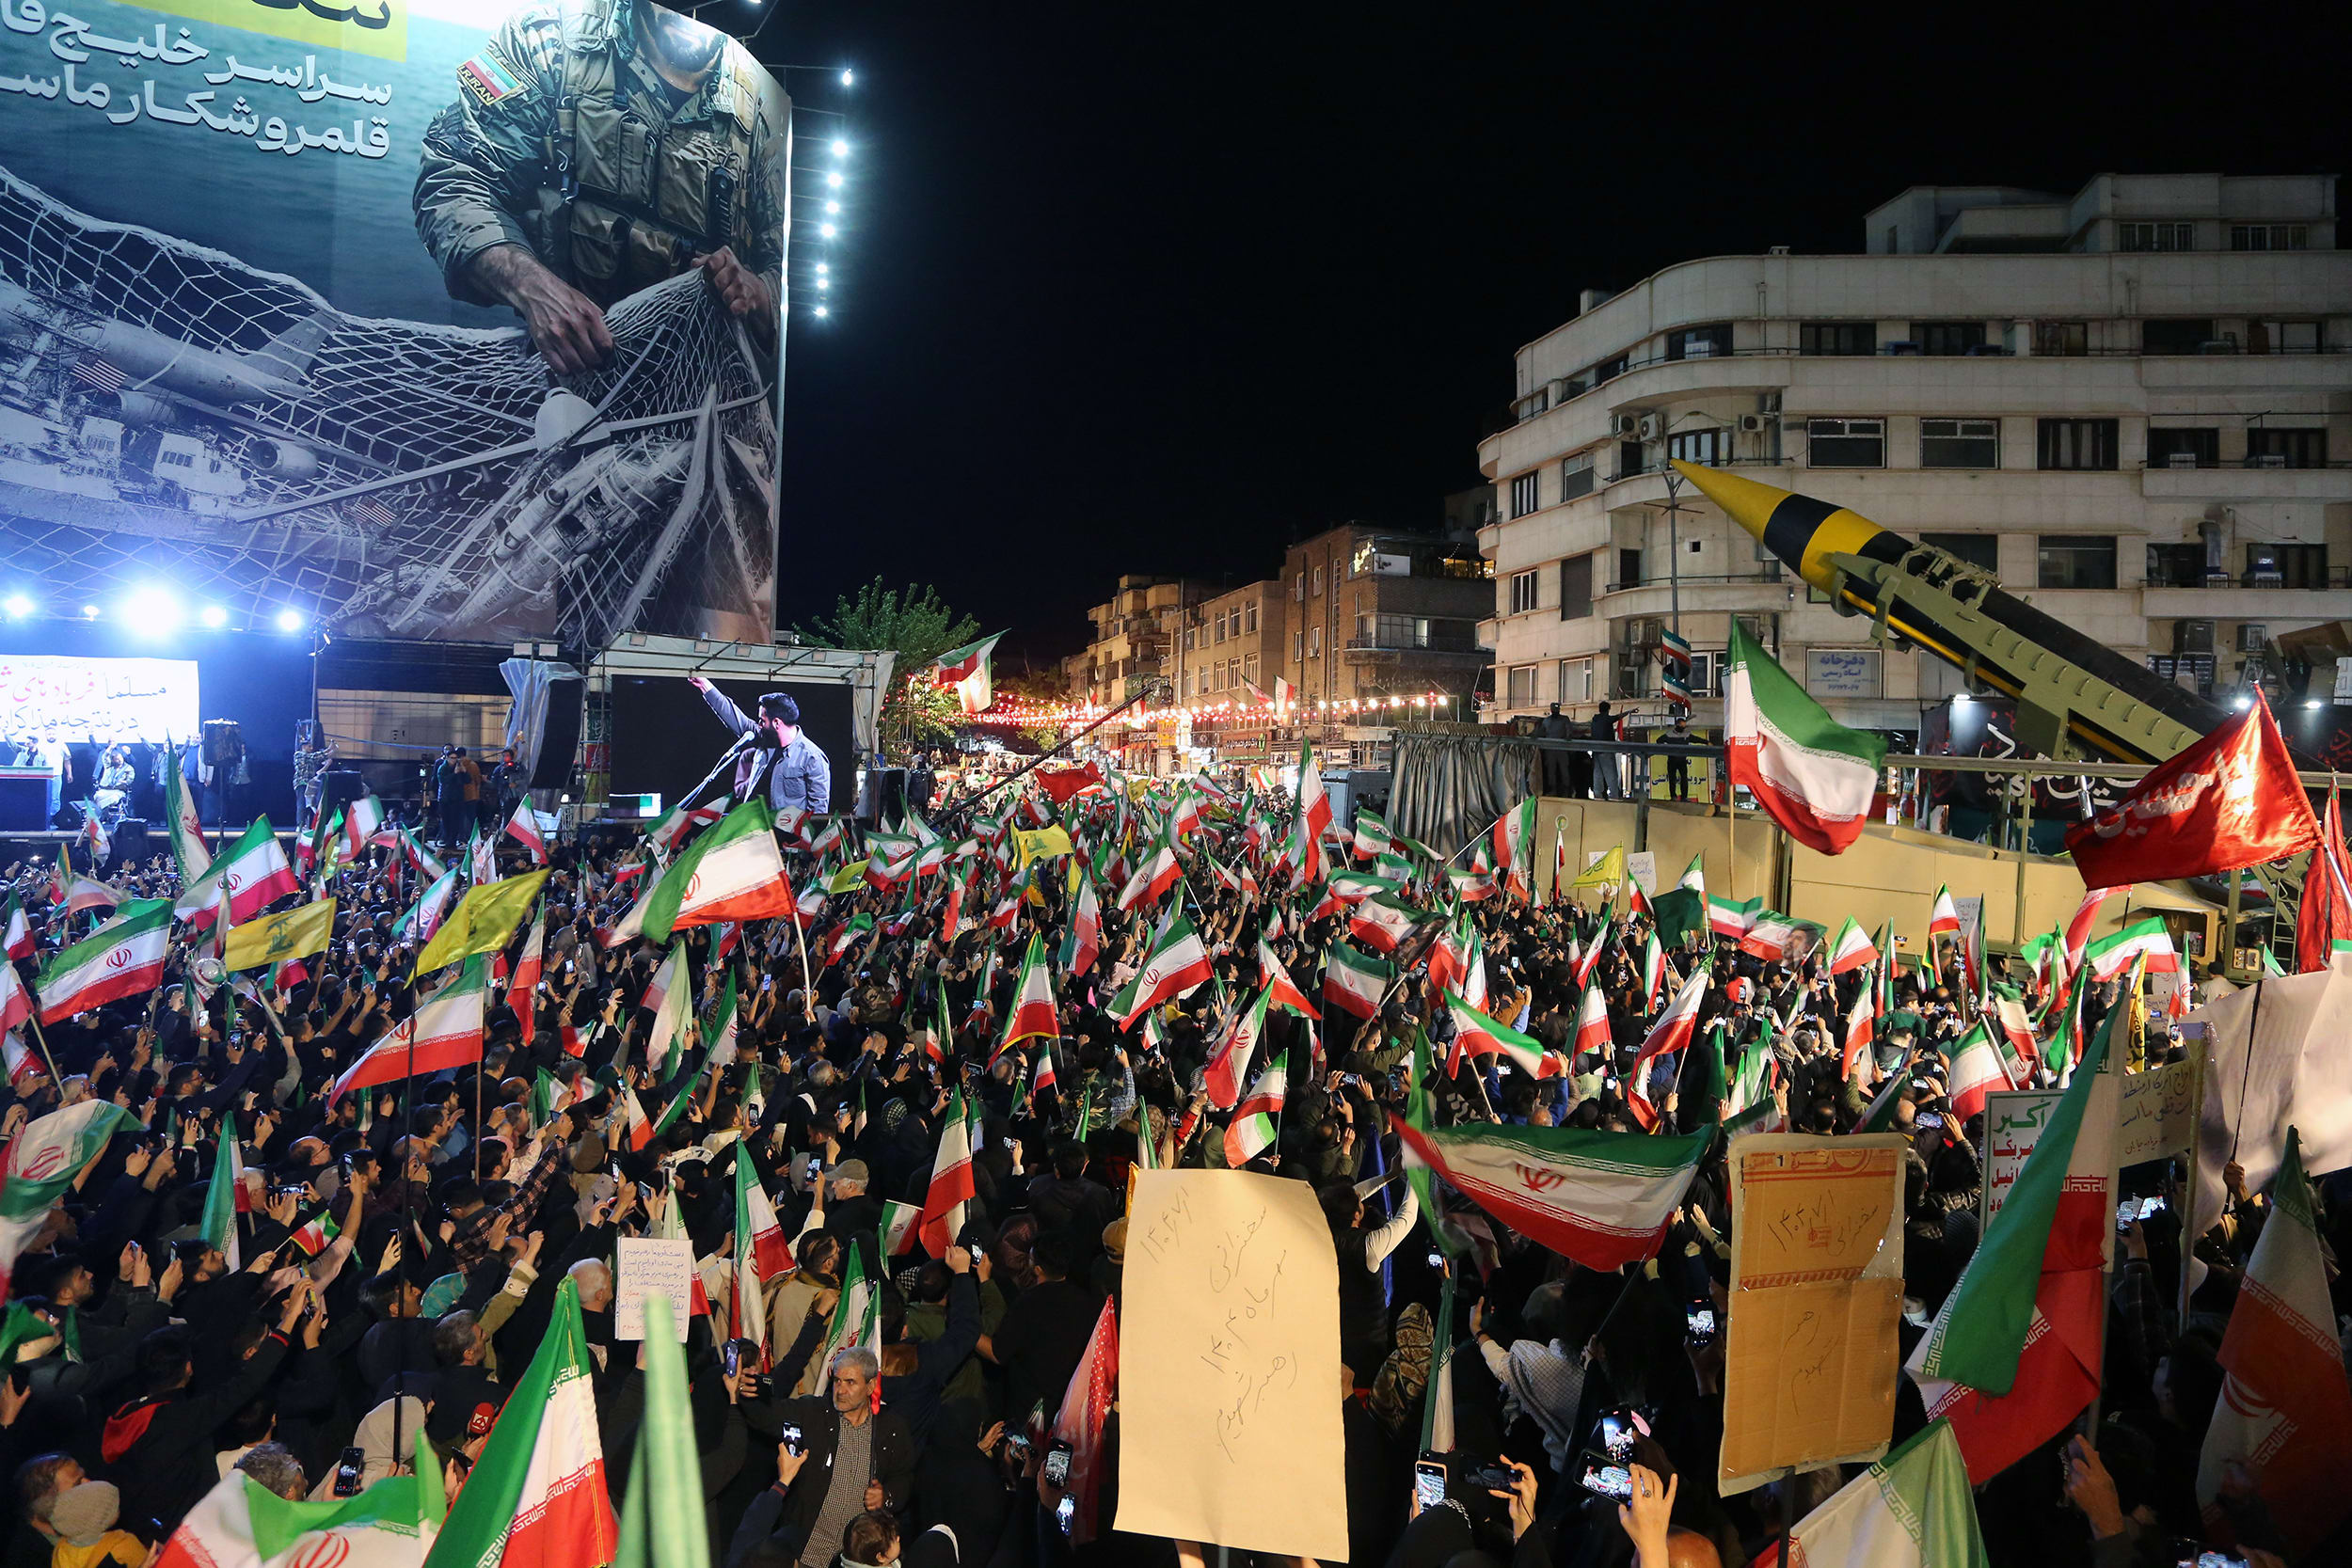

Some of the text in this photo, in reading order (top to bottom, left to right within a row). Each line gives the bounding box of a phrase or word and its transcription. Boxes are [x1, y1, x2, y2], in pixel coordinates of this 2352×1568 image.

[50, 12, 210, 68] خلیج
[204, 55, 392, 105] سراسر
[0, 63, 391, 159] قلمرو شکار ماس
